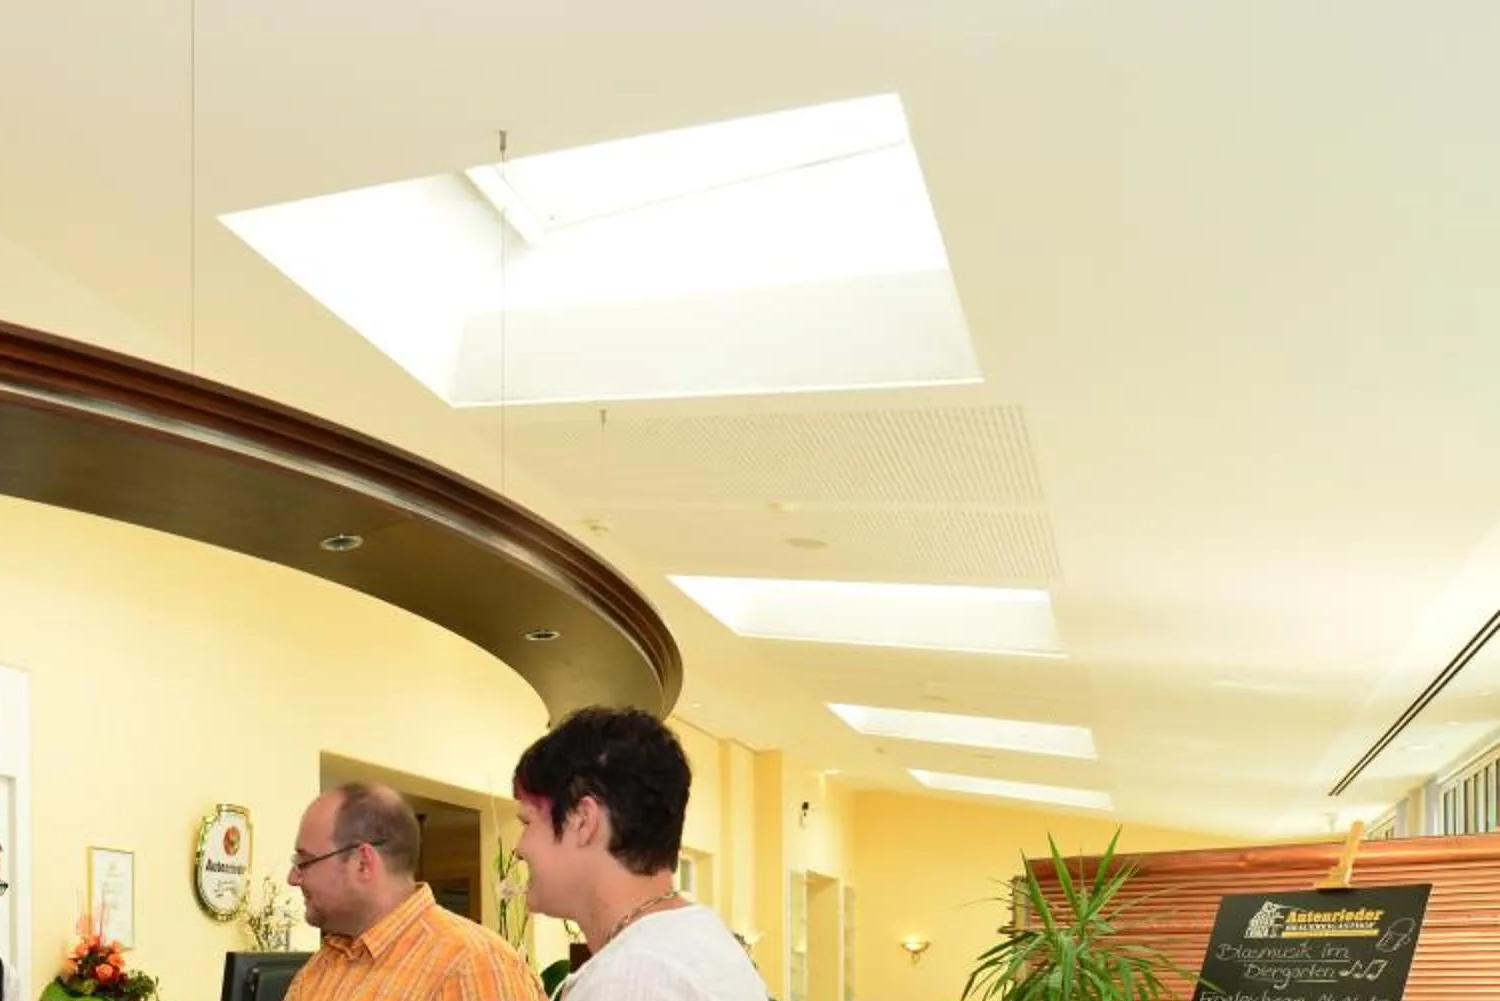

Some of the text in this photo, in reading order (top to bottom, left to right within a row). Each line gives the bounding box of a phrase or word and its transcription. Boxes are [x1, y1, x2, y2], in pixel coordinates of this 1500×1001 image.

[1285, 908, 1385, 923] Autenrieder
[1321, 942, 1350, 959] im
[1244, 963, 1336, 990] Biergarten
